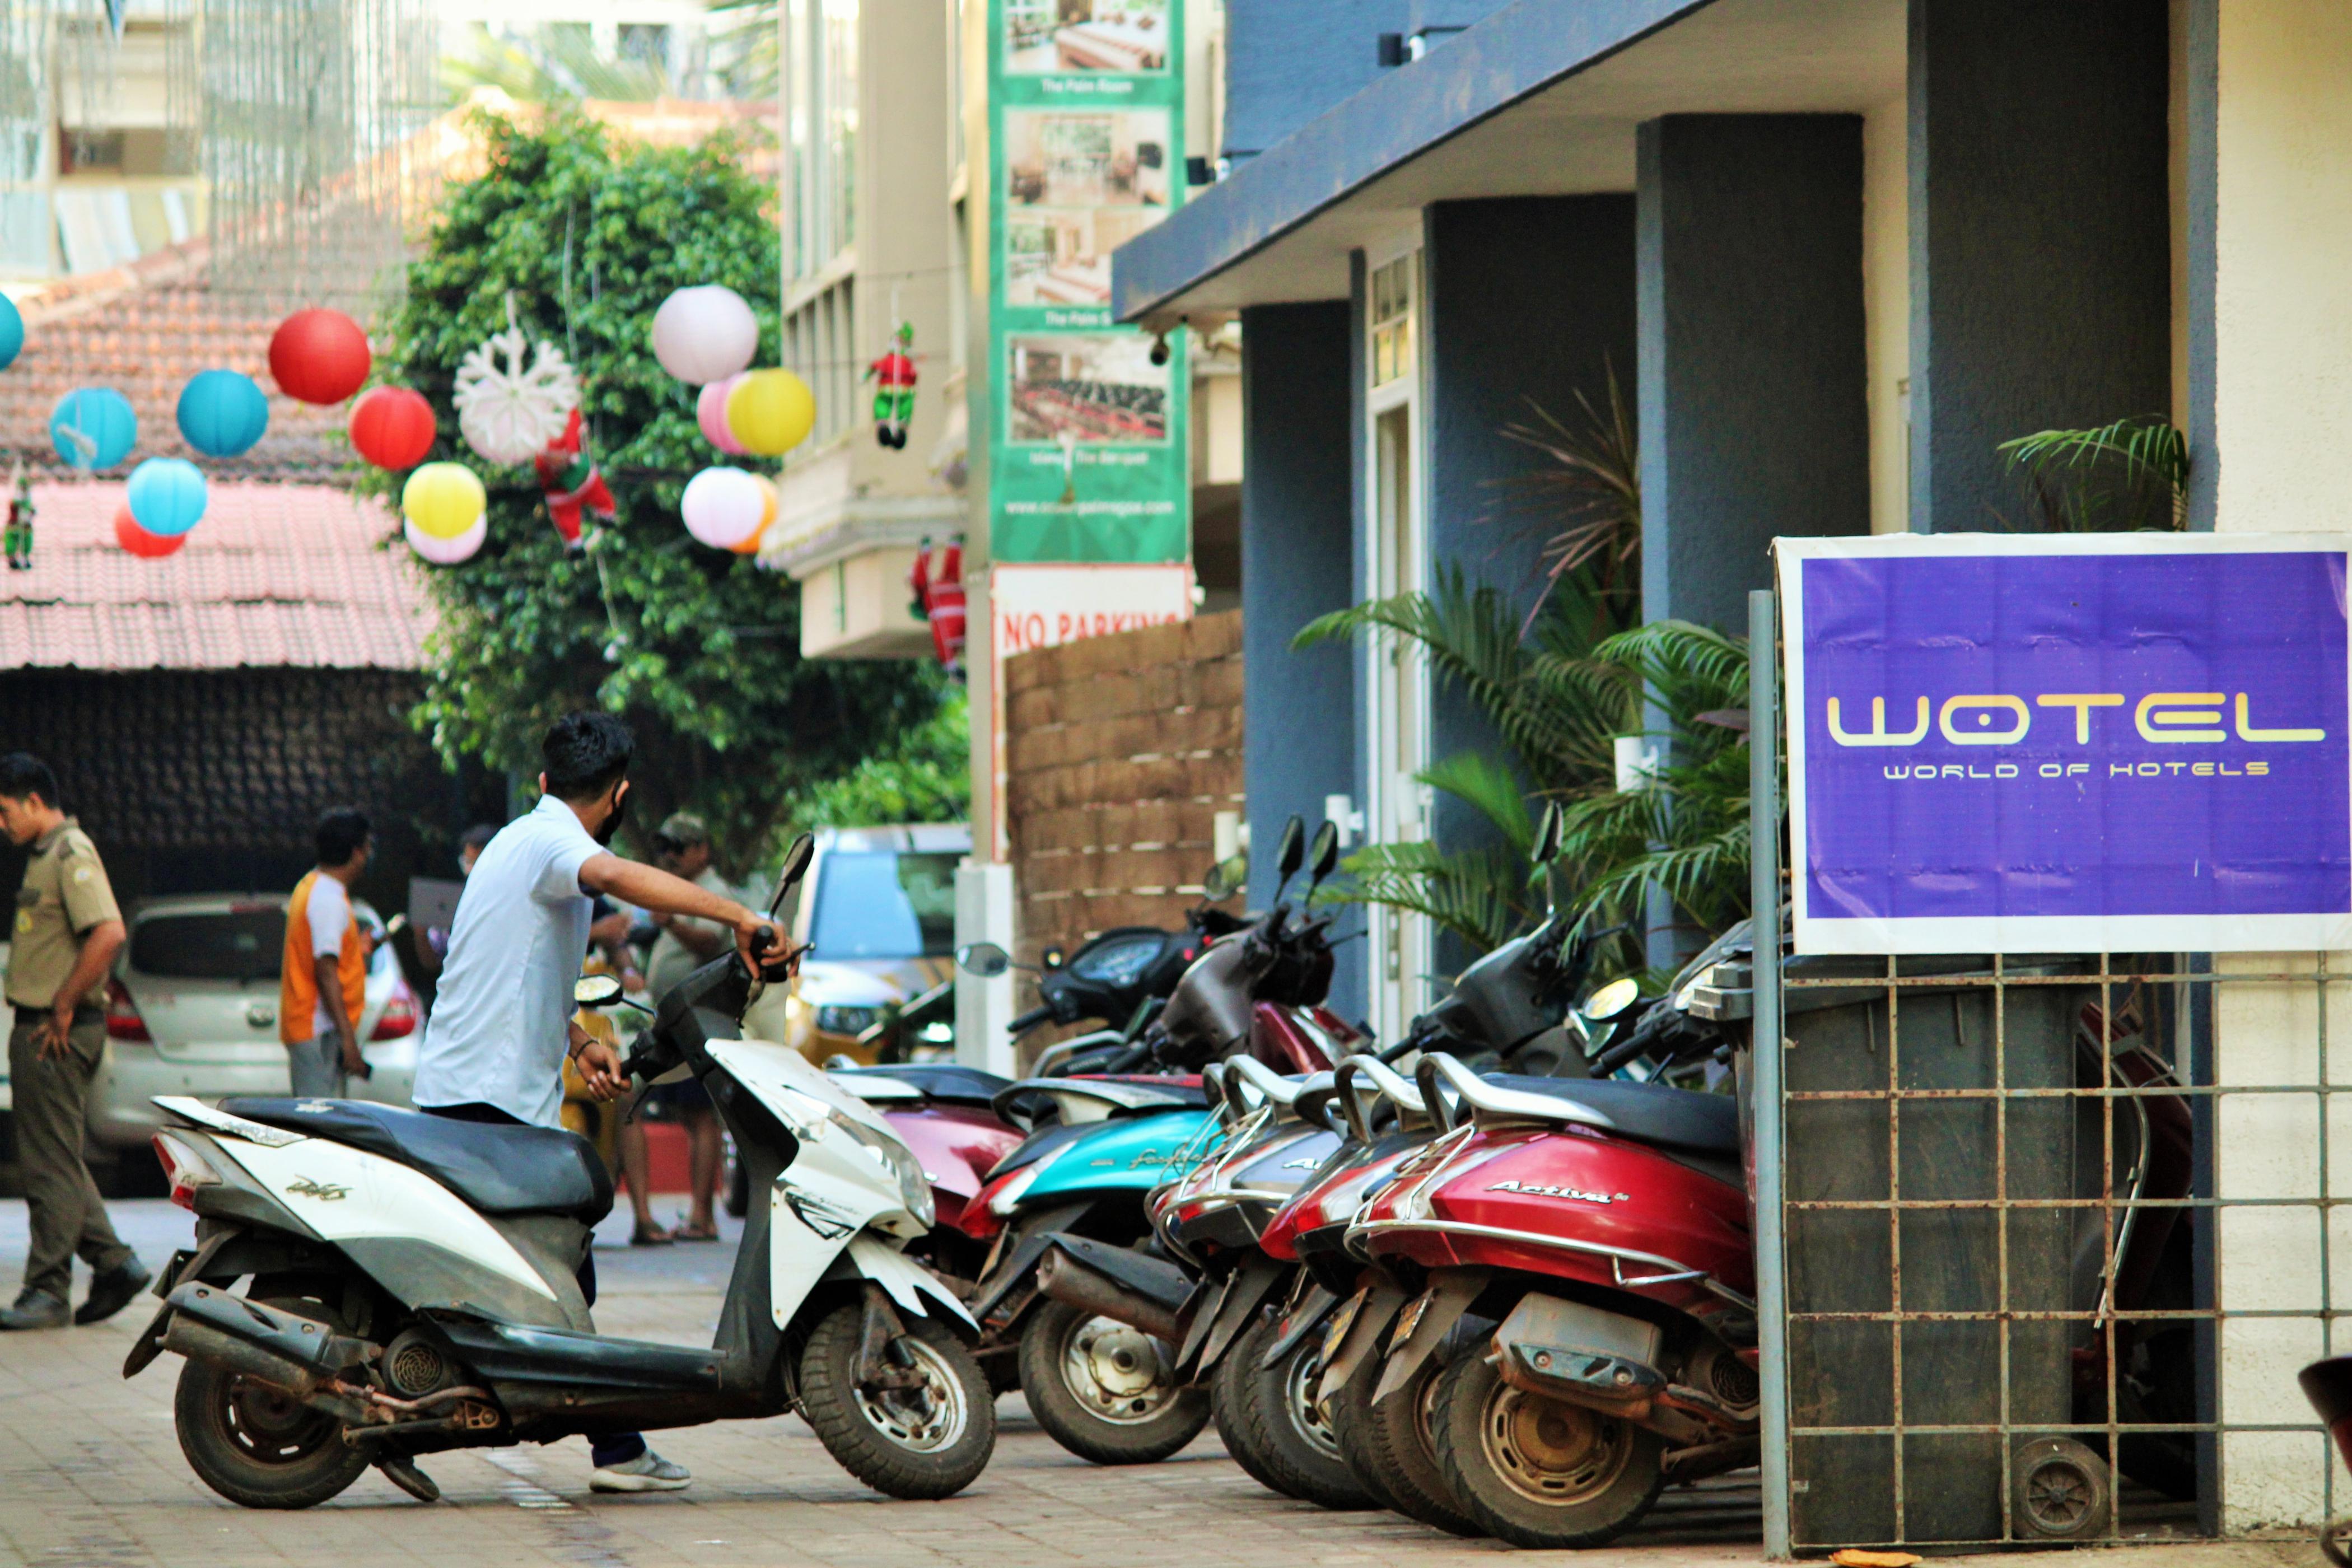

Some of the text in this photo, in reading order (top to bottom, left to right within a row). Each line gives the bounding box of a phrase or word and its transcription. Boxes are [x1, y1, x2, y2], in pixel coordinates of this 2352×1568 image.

[1042, 78, 1063, 92] The
[1045, 311, 1066, 325] The
[1004, 613, 1178, 648] NO PARK
[1827, 693, 2326, 746] WOTEL
[1884, 762, 2270, 780] WORLD OF HOTELS
[1484, 1180, 1612, 1203] Activa
